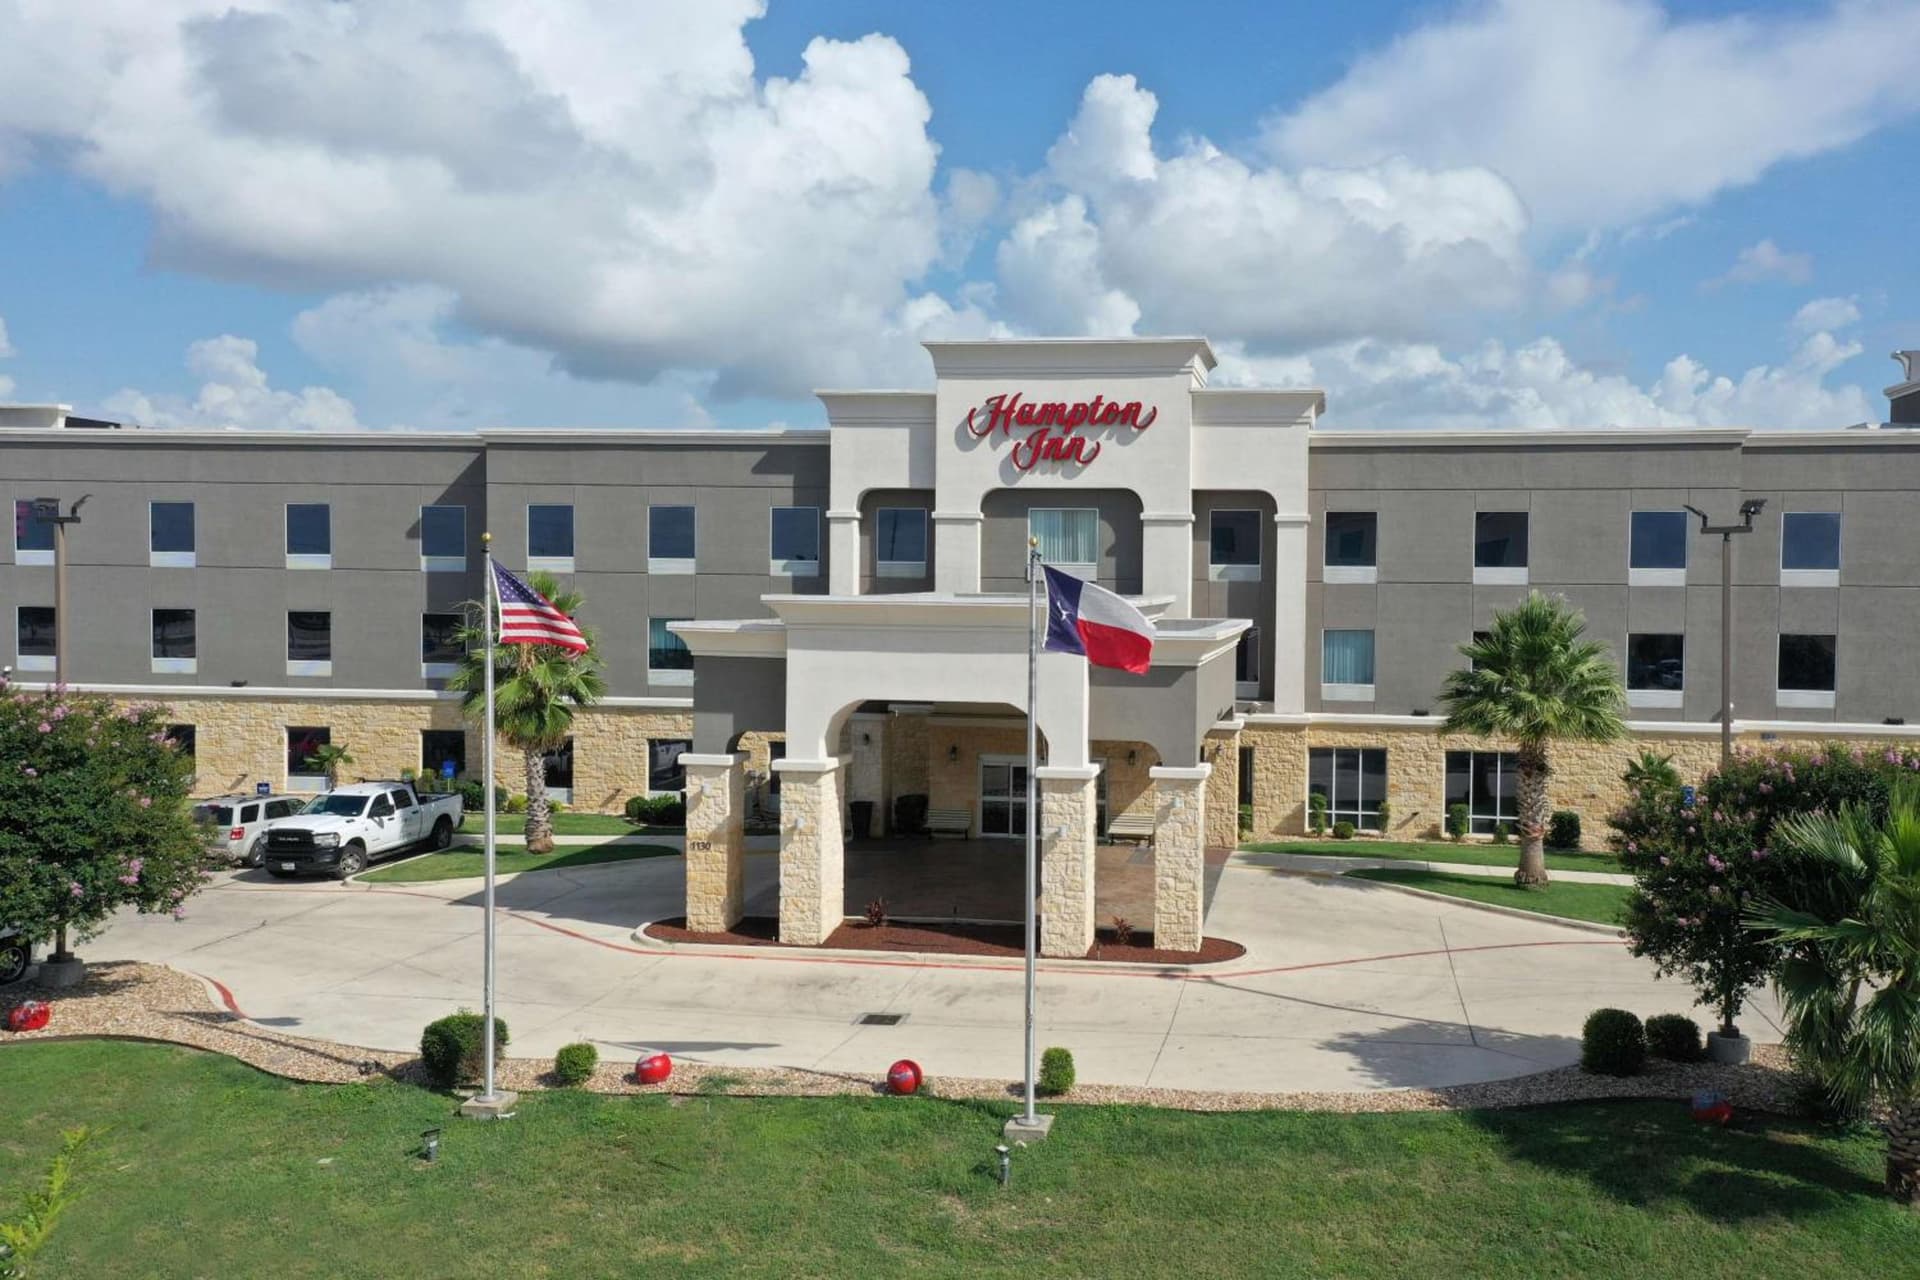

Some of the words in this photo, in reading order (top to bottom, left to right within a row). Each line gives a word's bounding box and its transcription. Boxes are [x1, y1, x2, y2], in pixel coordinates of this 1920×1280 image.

[968, 392, 1157, 436] Hampton
[1012, 428, 1100, 470] Inn
[691, 841, 711, 850] 1130
